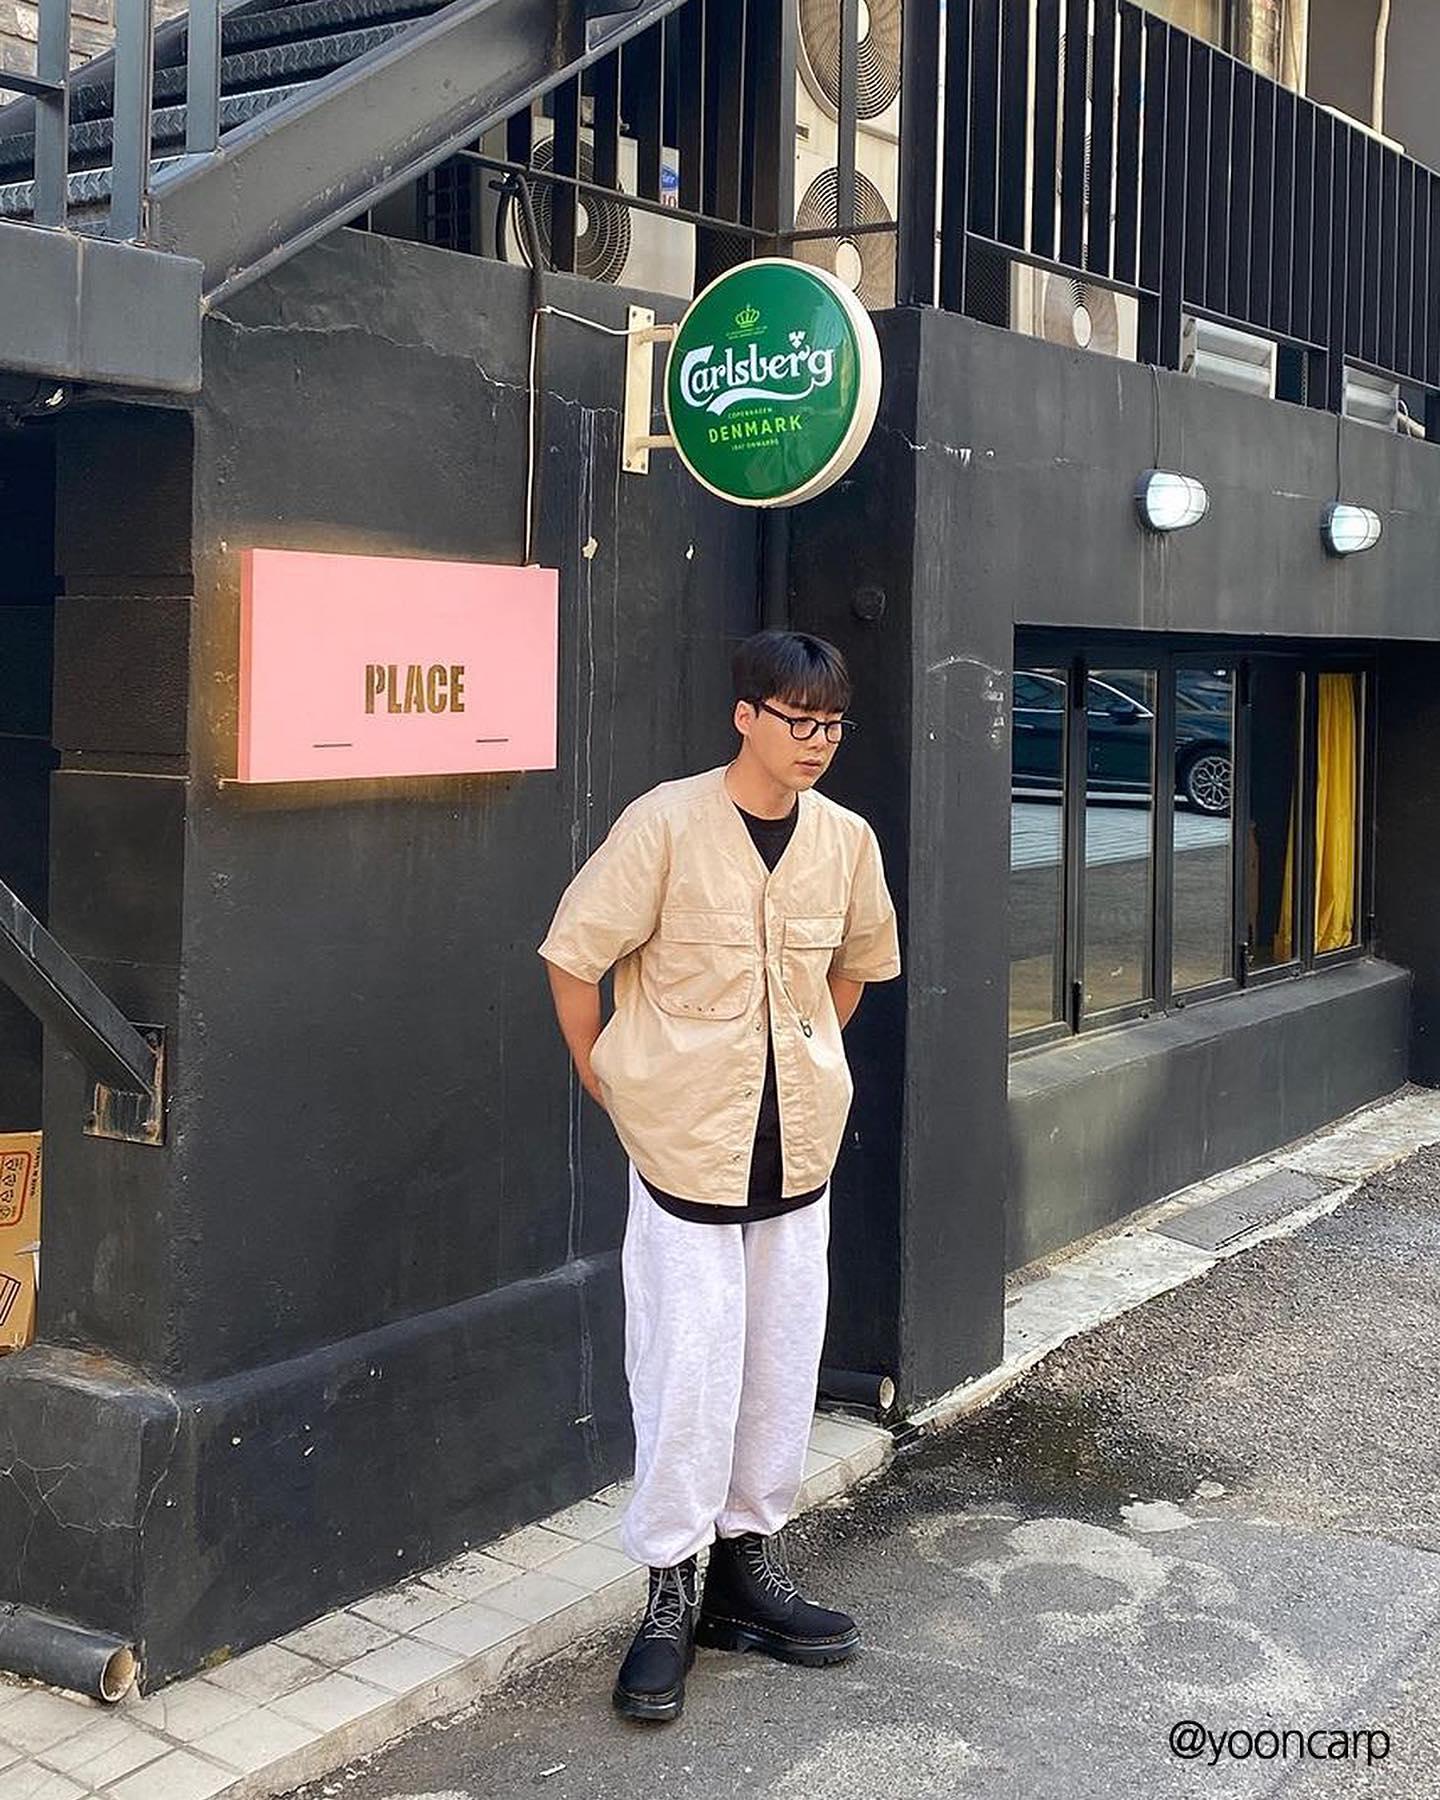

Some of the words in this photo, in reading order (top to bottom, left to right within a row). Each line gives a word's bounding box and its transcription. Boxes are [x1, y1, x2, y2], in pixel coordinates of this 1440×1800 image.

[680, 343, 834, 407] Carlsberg
[708, 414, 803, 443] DENMARK
[365, 664, 465, 715] PLACE
